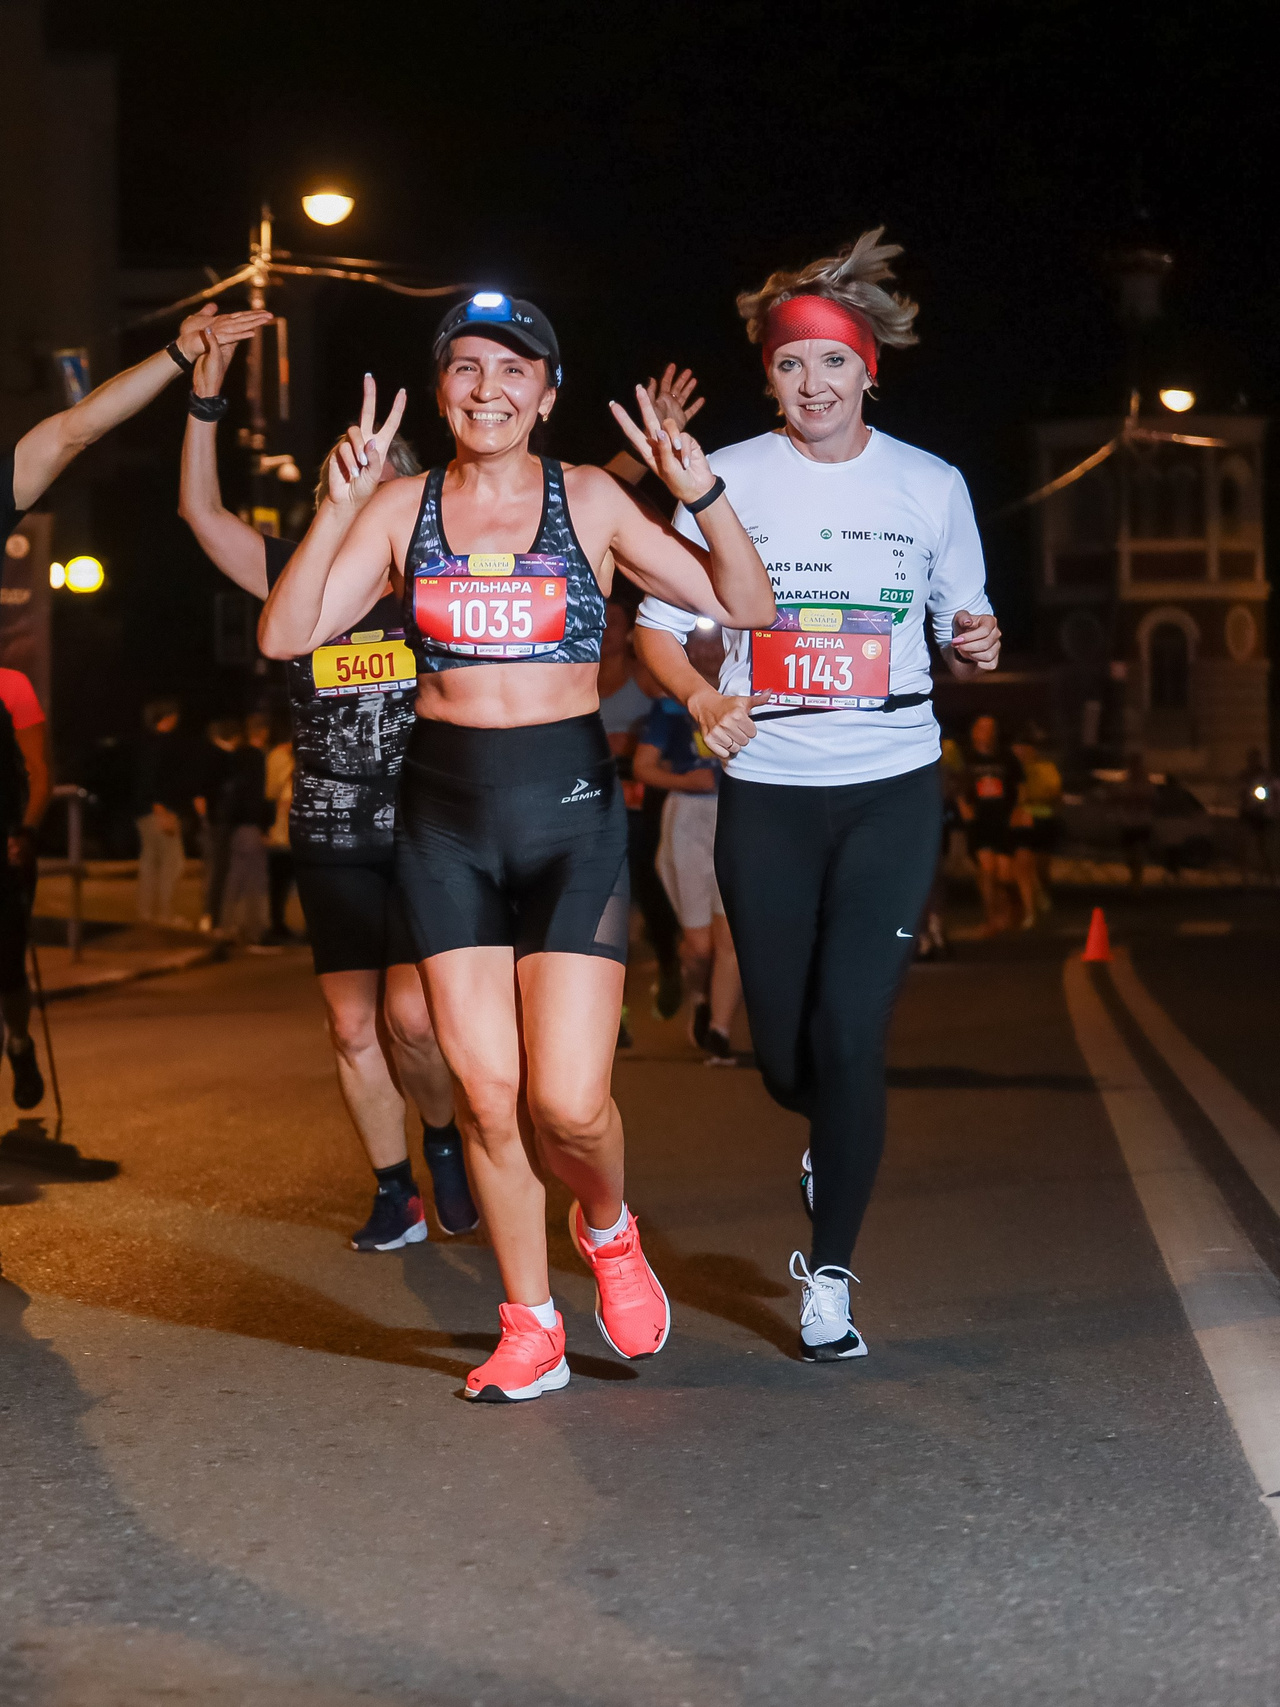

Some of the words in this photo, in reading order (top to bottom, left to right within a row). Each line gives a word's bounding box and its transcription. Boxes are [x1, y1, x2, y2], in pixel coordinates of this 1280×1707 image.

[892, 549, 905, 558] 06
[766, 562, 791, 572] ARS
[795, 562, 833, 572] BANK
[894, 572, 907, 581] 10
[449, 581, 532, 594] ГУЛЬНАРА
[773, 590, 850, 601] MARATHON
[881, 590, 913, 602] 2019
[448, 599, 533, 639] 1035
[794, 636, 844, 650] АЛЕНА
[336, 652, 395, 682] 5401
[783, 653, 853, 692] 1143
[561, 789, 602, 804] DEMIX
